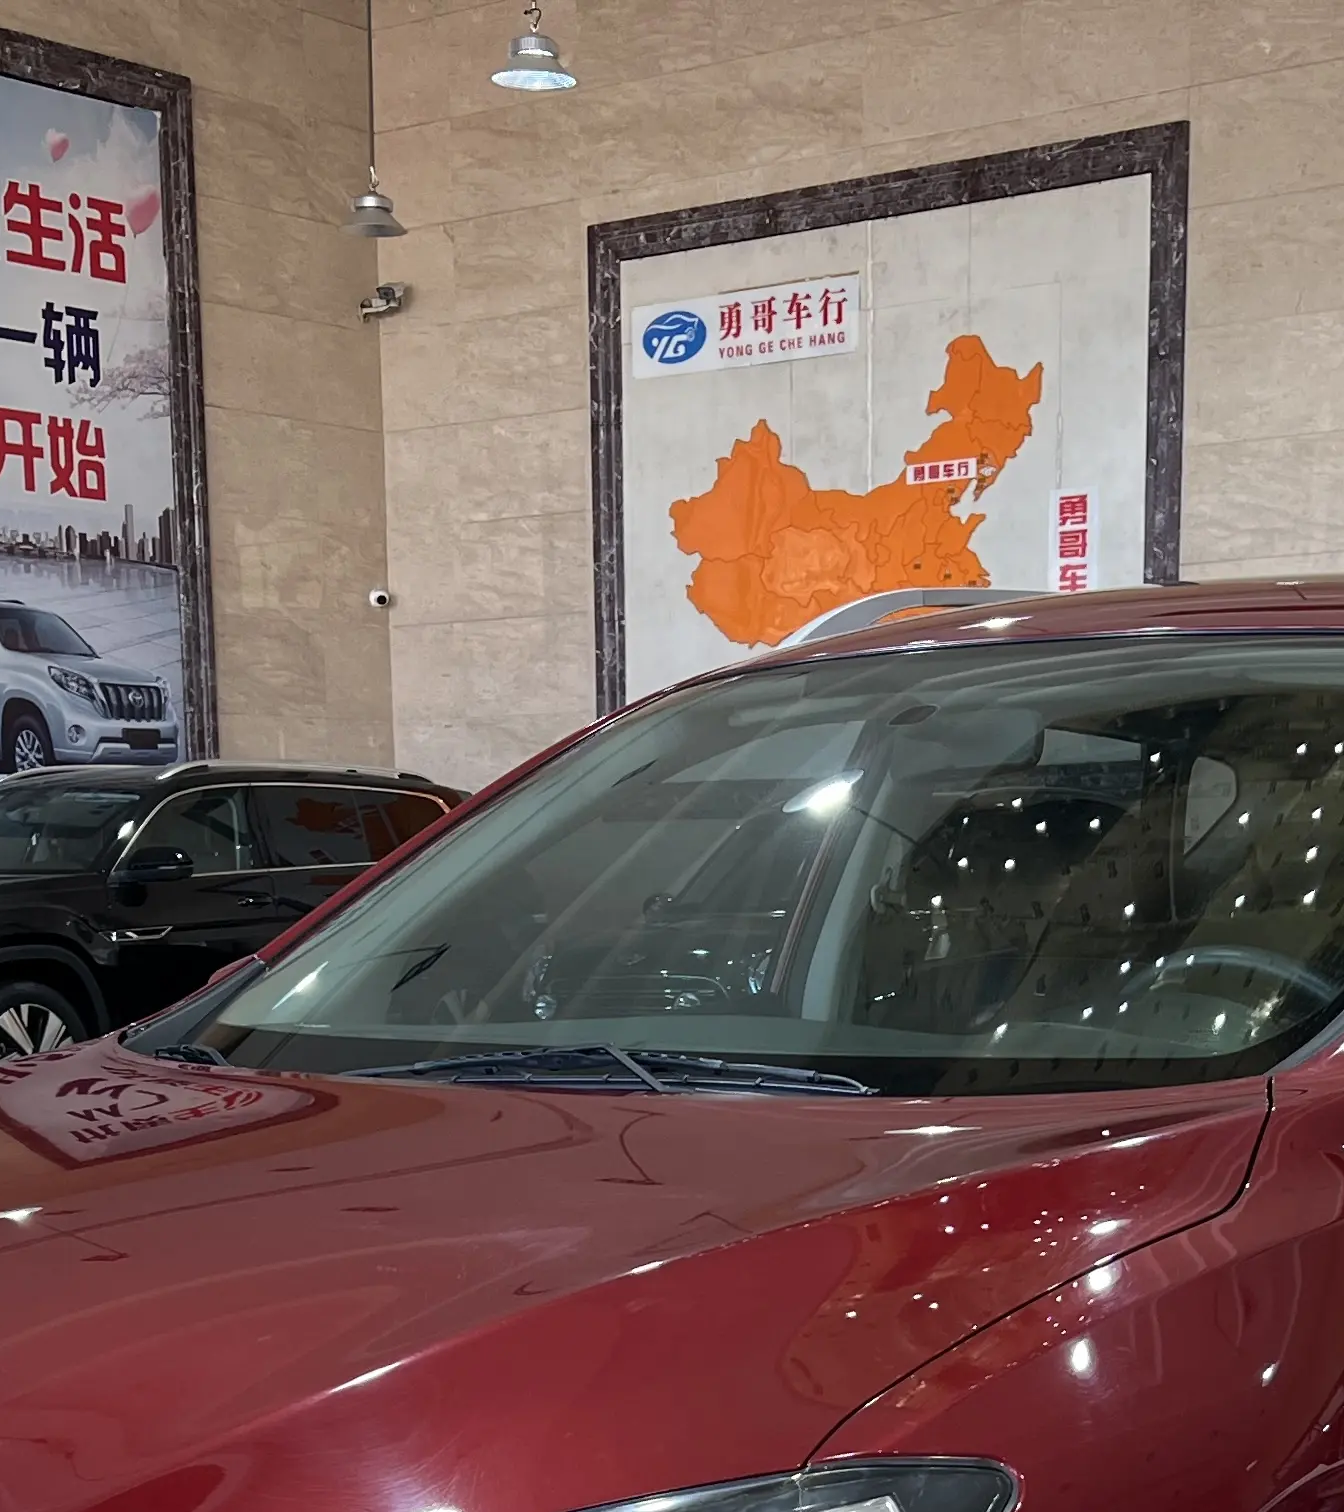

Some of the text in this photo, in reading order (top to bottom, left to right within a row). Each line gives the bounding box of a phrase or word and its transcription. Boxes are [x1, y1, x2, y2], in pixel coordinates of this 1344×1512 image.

[718, 287, 848, 341] 勇哥车行
[718, 331, 846, 359] YONG GE CHE HANG
